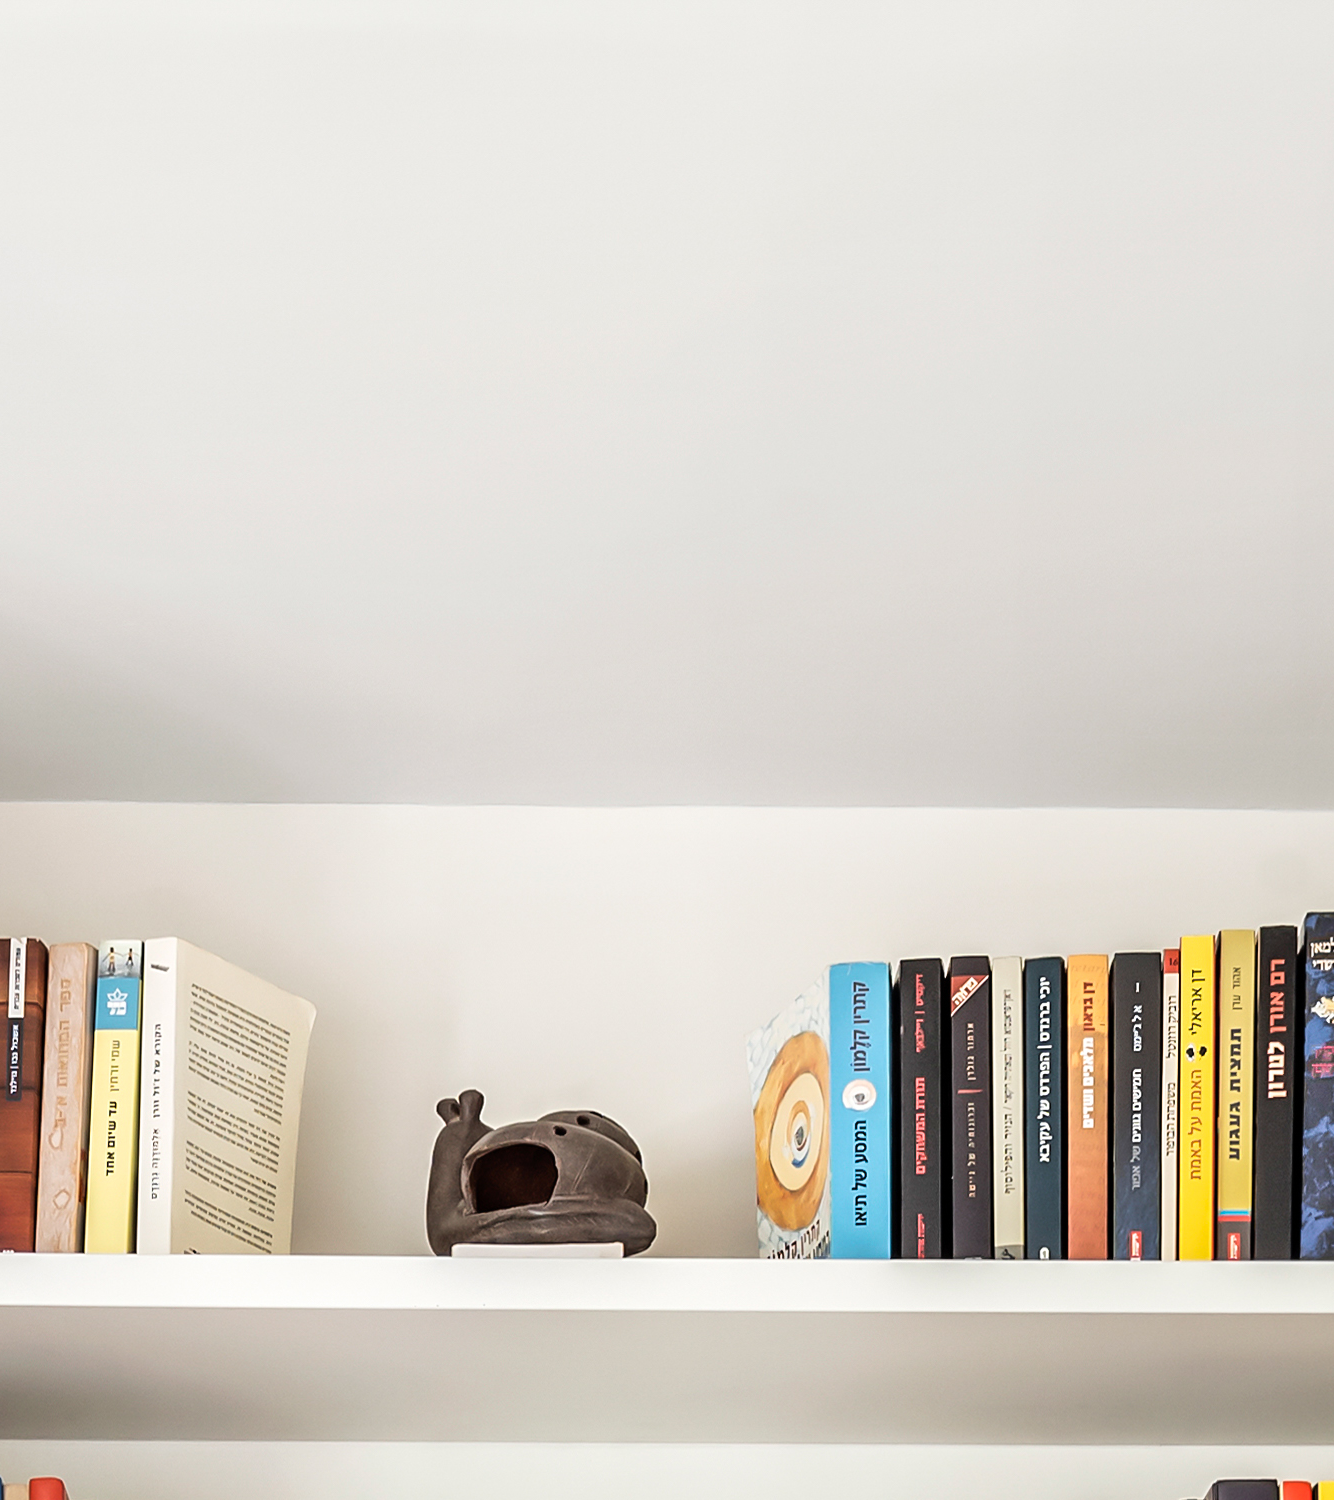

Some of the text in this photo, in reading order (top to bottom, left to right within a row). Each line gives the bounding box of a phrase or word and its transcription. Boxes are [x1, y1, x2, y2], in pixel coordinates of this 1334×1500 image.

[1037, 977, 1052, 1162] יוכי ברנדס הפרדס של עקיבא
[1080, 982, 1095, 1128] דן בראון מלאכים ושדים
[1230, 1029, 1241, 1092] תמצית
[1233, 995, 1242, 1009] ערן
[1267, 959, 1287, 1098] רם אורן לטרון
[106, 1040, 120, 1176] שמי זרחין עד שיום אחד
[1188, 970, 1205, 1180] דן אריאלי האמת על באמת
[1229, 1102, 1240, 1160] געגוע
